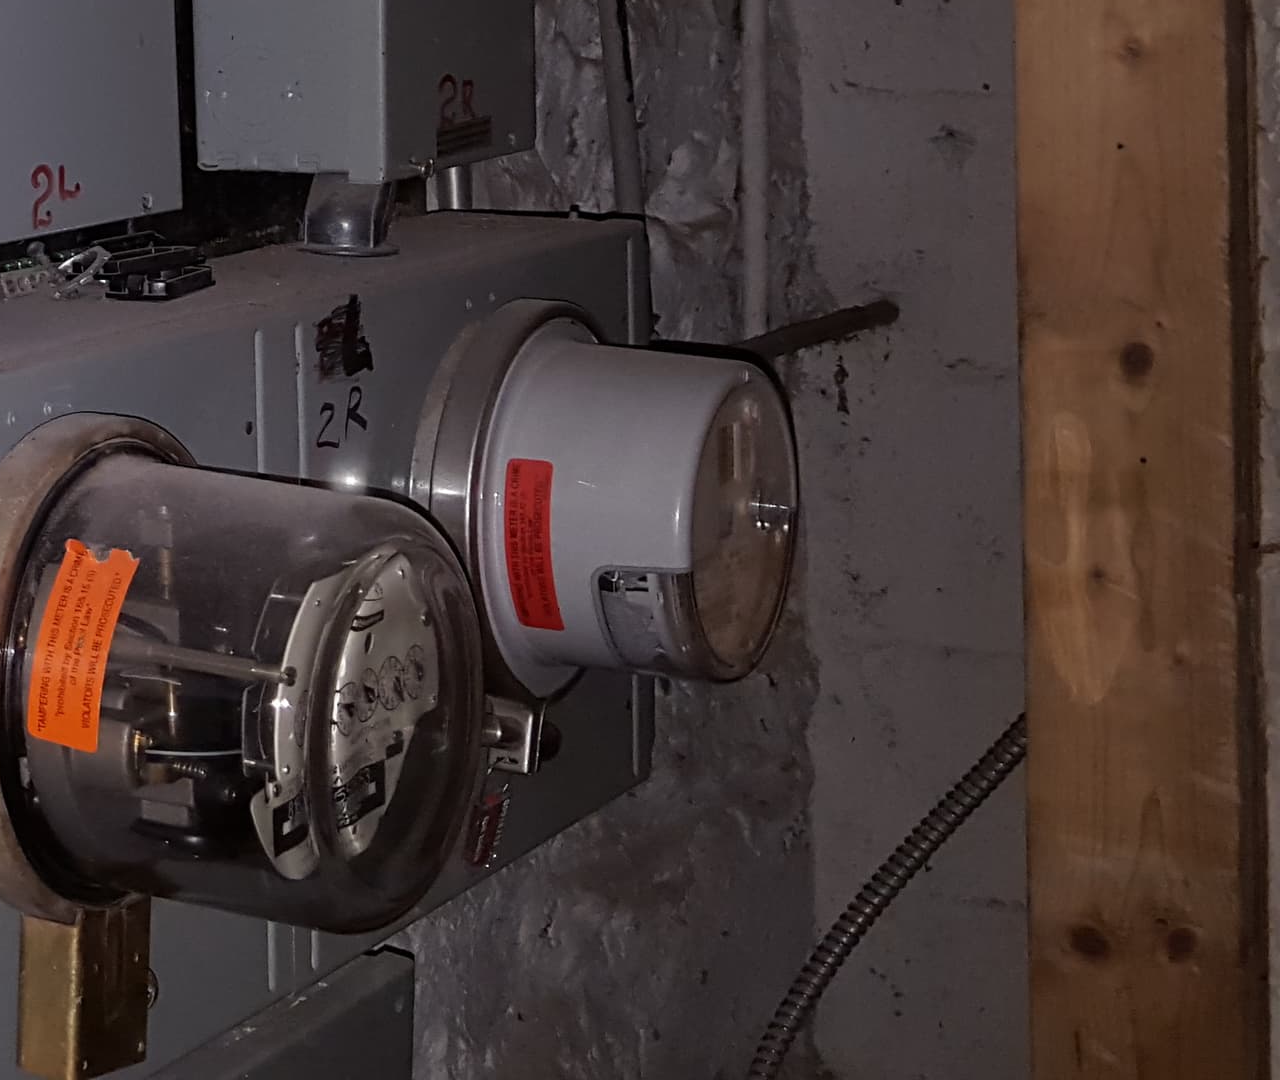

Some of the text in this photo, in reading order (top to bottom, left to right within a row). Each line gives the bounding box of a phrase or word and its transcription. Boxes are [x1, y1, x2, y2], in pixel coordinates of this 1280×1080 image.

[30, 163, 81, 230] 2L
[64, 584, 73, 594] IS
[53, 594, 67, 626] METER
[47, 625, 59, 648] THIS
[43, 650, 56, 674] WITH
